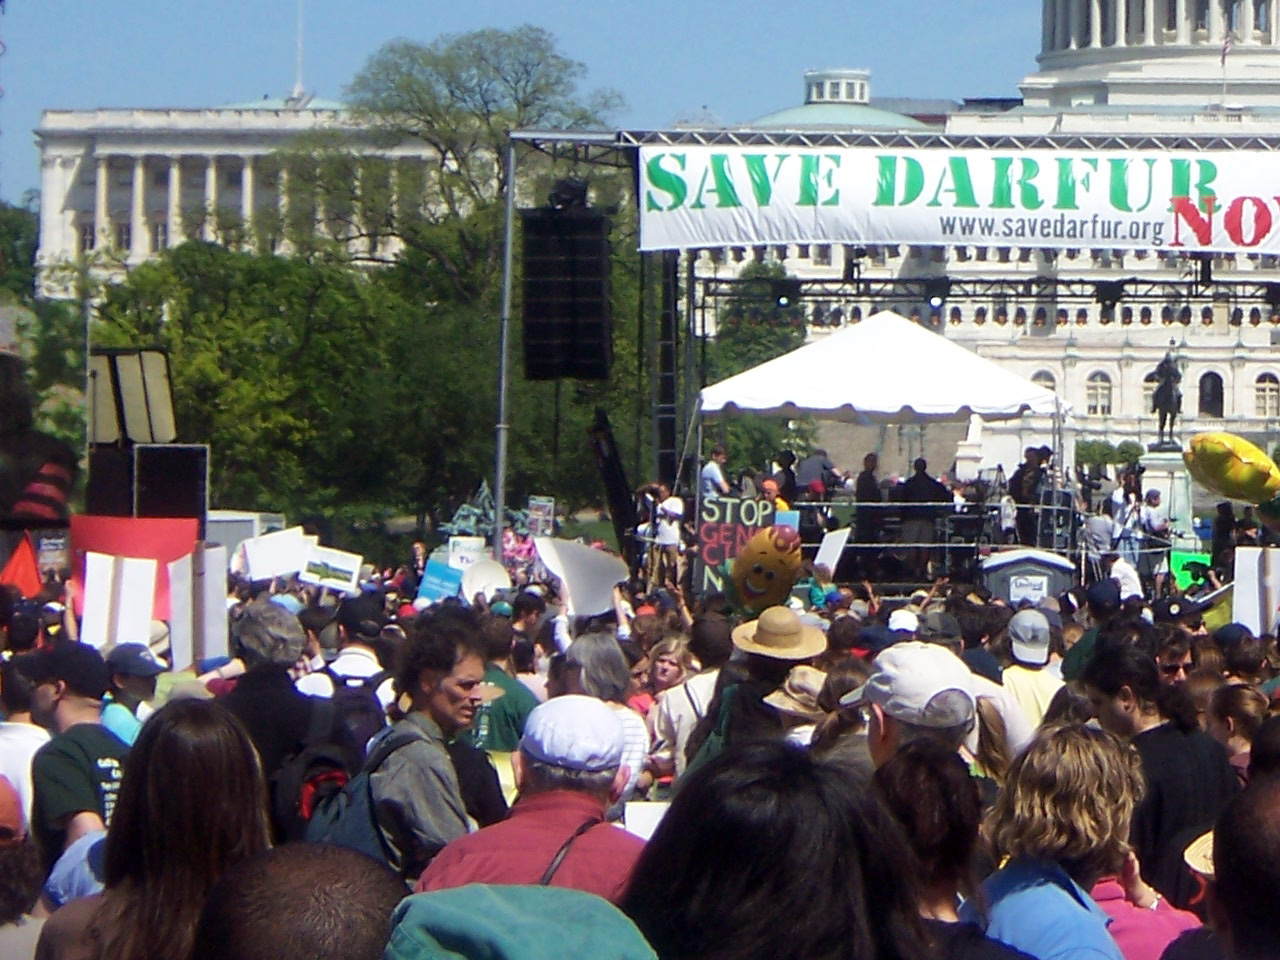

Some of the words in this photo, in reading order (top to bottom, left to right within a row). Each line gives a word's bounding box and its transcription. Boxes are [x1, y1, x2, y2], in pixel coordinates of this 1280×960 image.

[646, 152, 841, 213] SAVE
[871, 154, 1221, 213] DARFUR
[938, 212, 1166, 247] www.savedarfur.org
[701, 497, 774, 527] STOP
[700, 523, 758, 544] GEN
